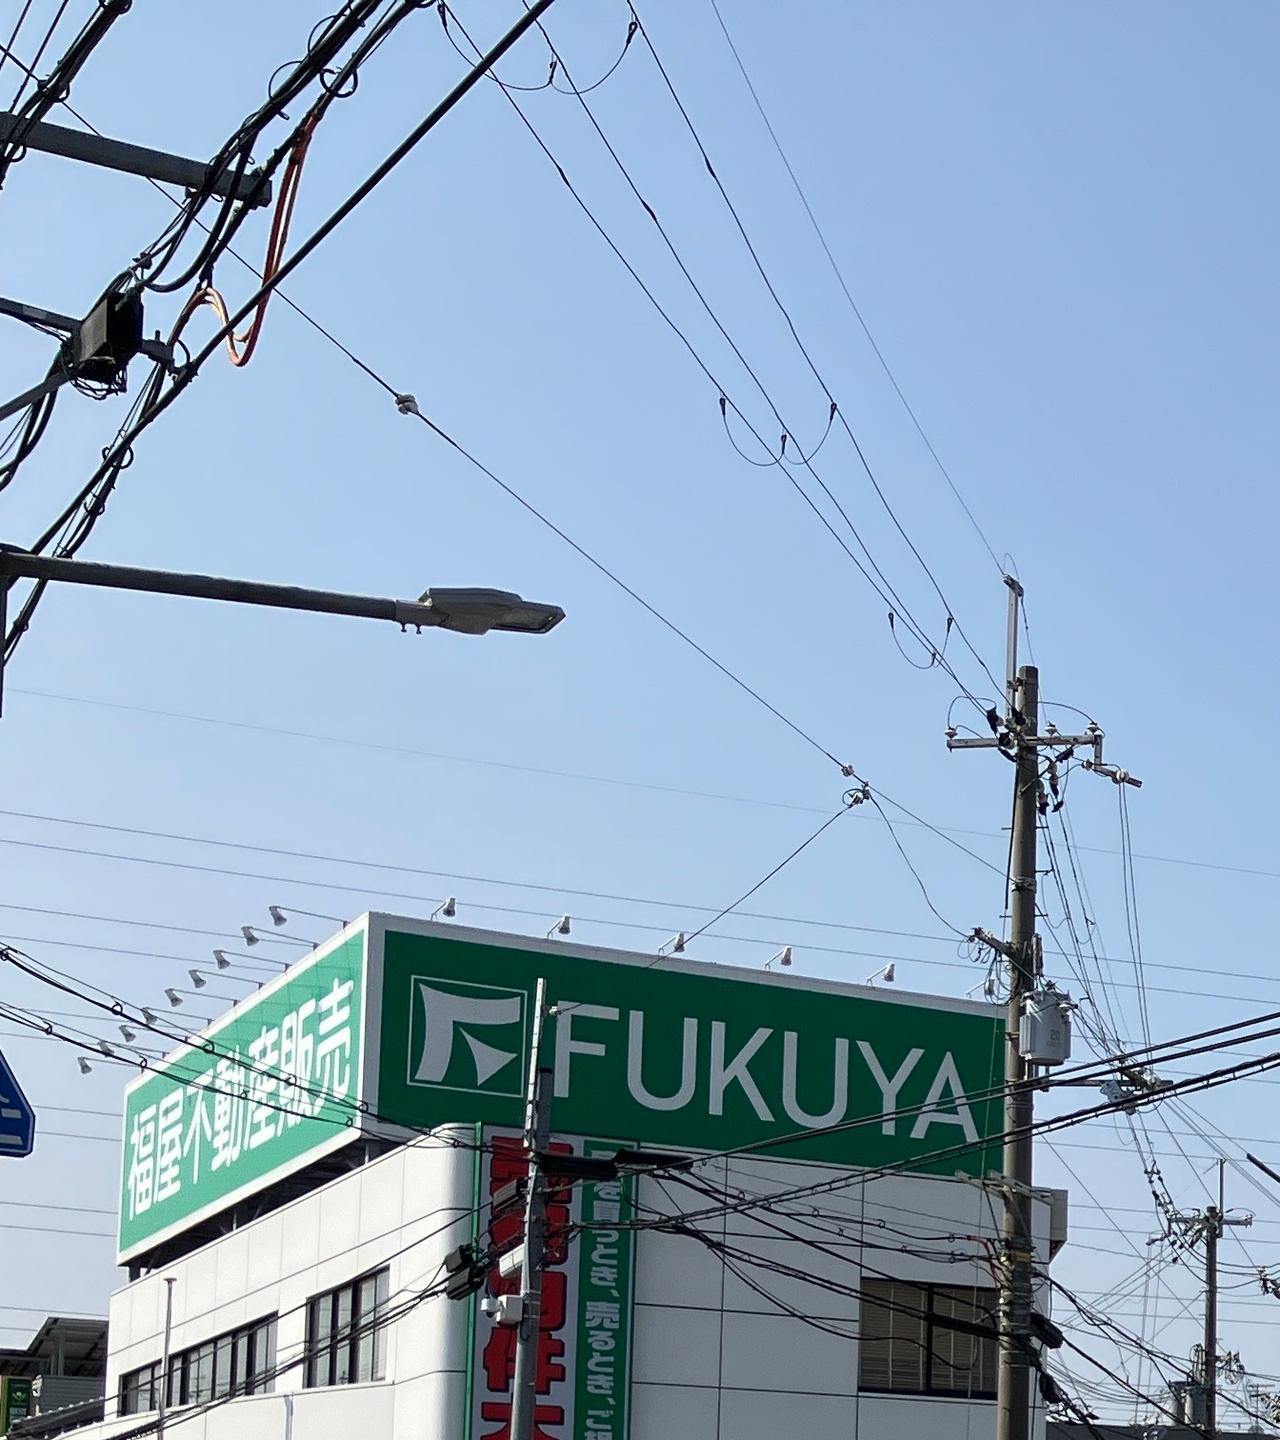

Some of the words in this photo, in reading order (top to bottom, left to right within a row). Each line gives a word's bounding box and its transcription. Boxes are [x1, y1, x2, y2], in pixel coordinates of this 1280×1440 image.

[127, 977, 355, 1221] 福屋不動産販売
[552, 1000, 978, 1143] FUKUYA
